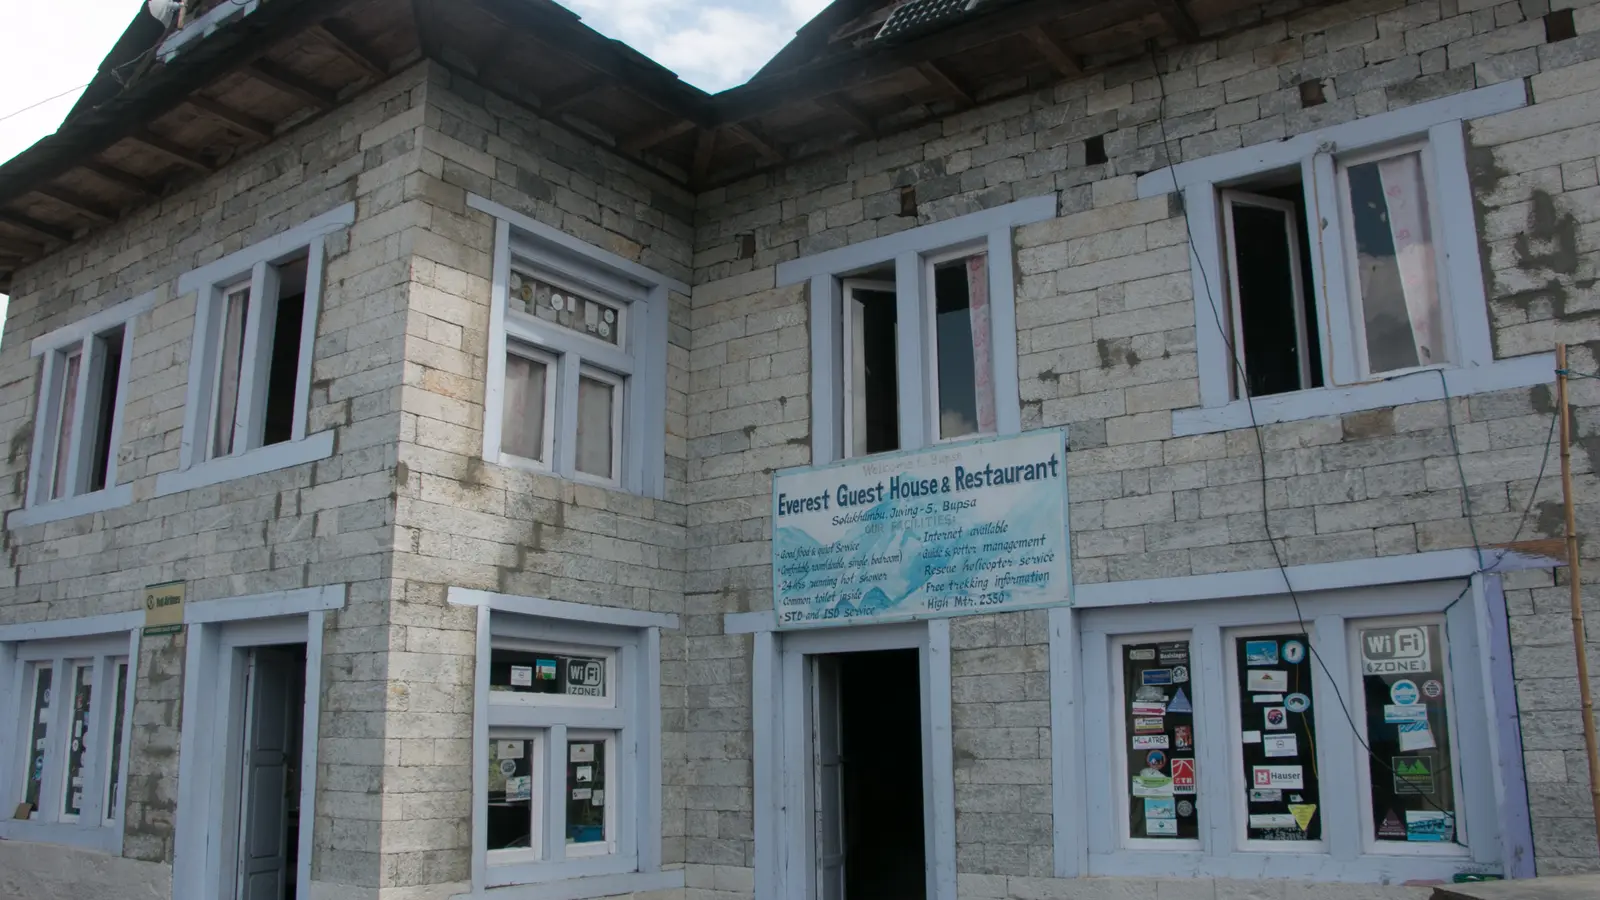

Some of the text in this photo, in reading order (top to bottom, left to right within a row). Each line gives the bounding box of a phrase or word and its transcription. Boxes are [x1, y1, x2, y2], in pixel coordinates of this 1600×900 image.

[778, 453, 1059, 516] Everest Guest House & Restaurant
[943, 499, 977, 513] Bupsa
[924, 520, 1008, 543] Internet available
[780, 548, 796, 560] Good
[795, 544, 811, 560] food
[945, 549, 952, 557] &
[983, 533, 1046, 553] management
[925, 563, 957, 576] Rescue
[1020, 552, 1054, 567] service
[840, 573, 854, 585] hot
[859, 572, 888, 583] shower
[926, 571, 1050, 594] Free trekking information
[783, 588, 862, 606] Common toilet inside
[927, 595, 948, 611] High
[980, 591, 1005, 605] 2350
[785, 605, 875, 622] STD and ISD service
[1367, 633, 1419, 653] WiFi
[570, 665, 598, 680] WiFi
[1374, 660, 1419, 672] ZONE
[571, 687, 597, 696] ZONE
[1271, 772, 1300, 780] Hauser
